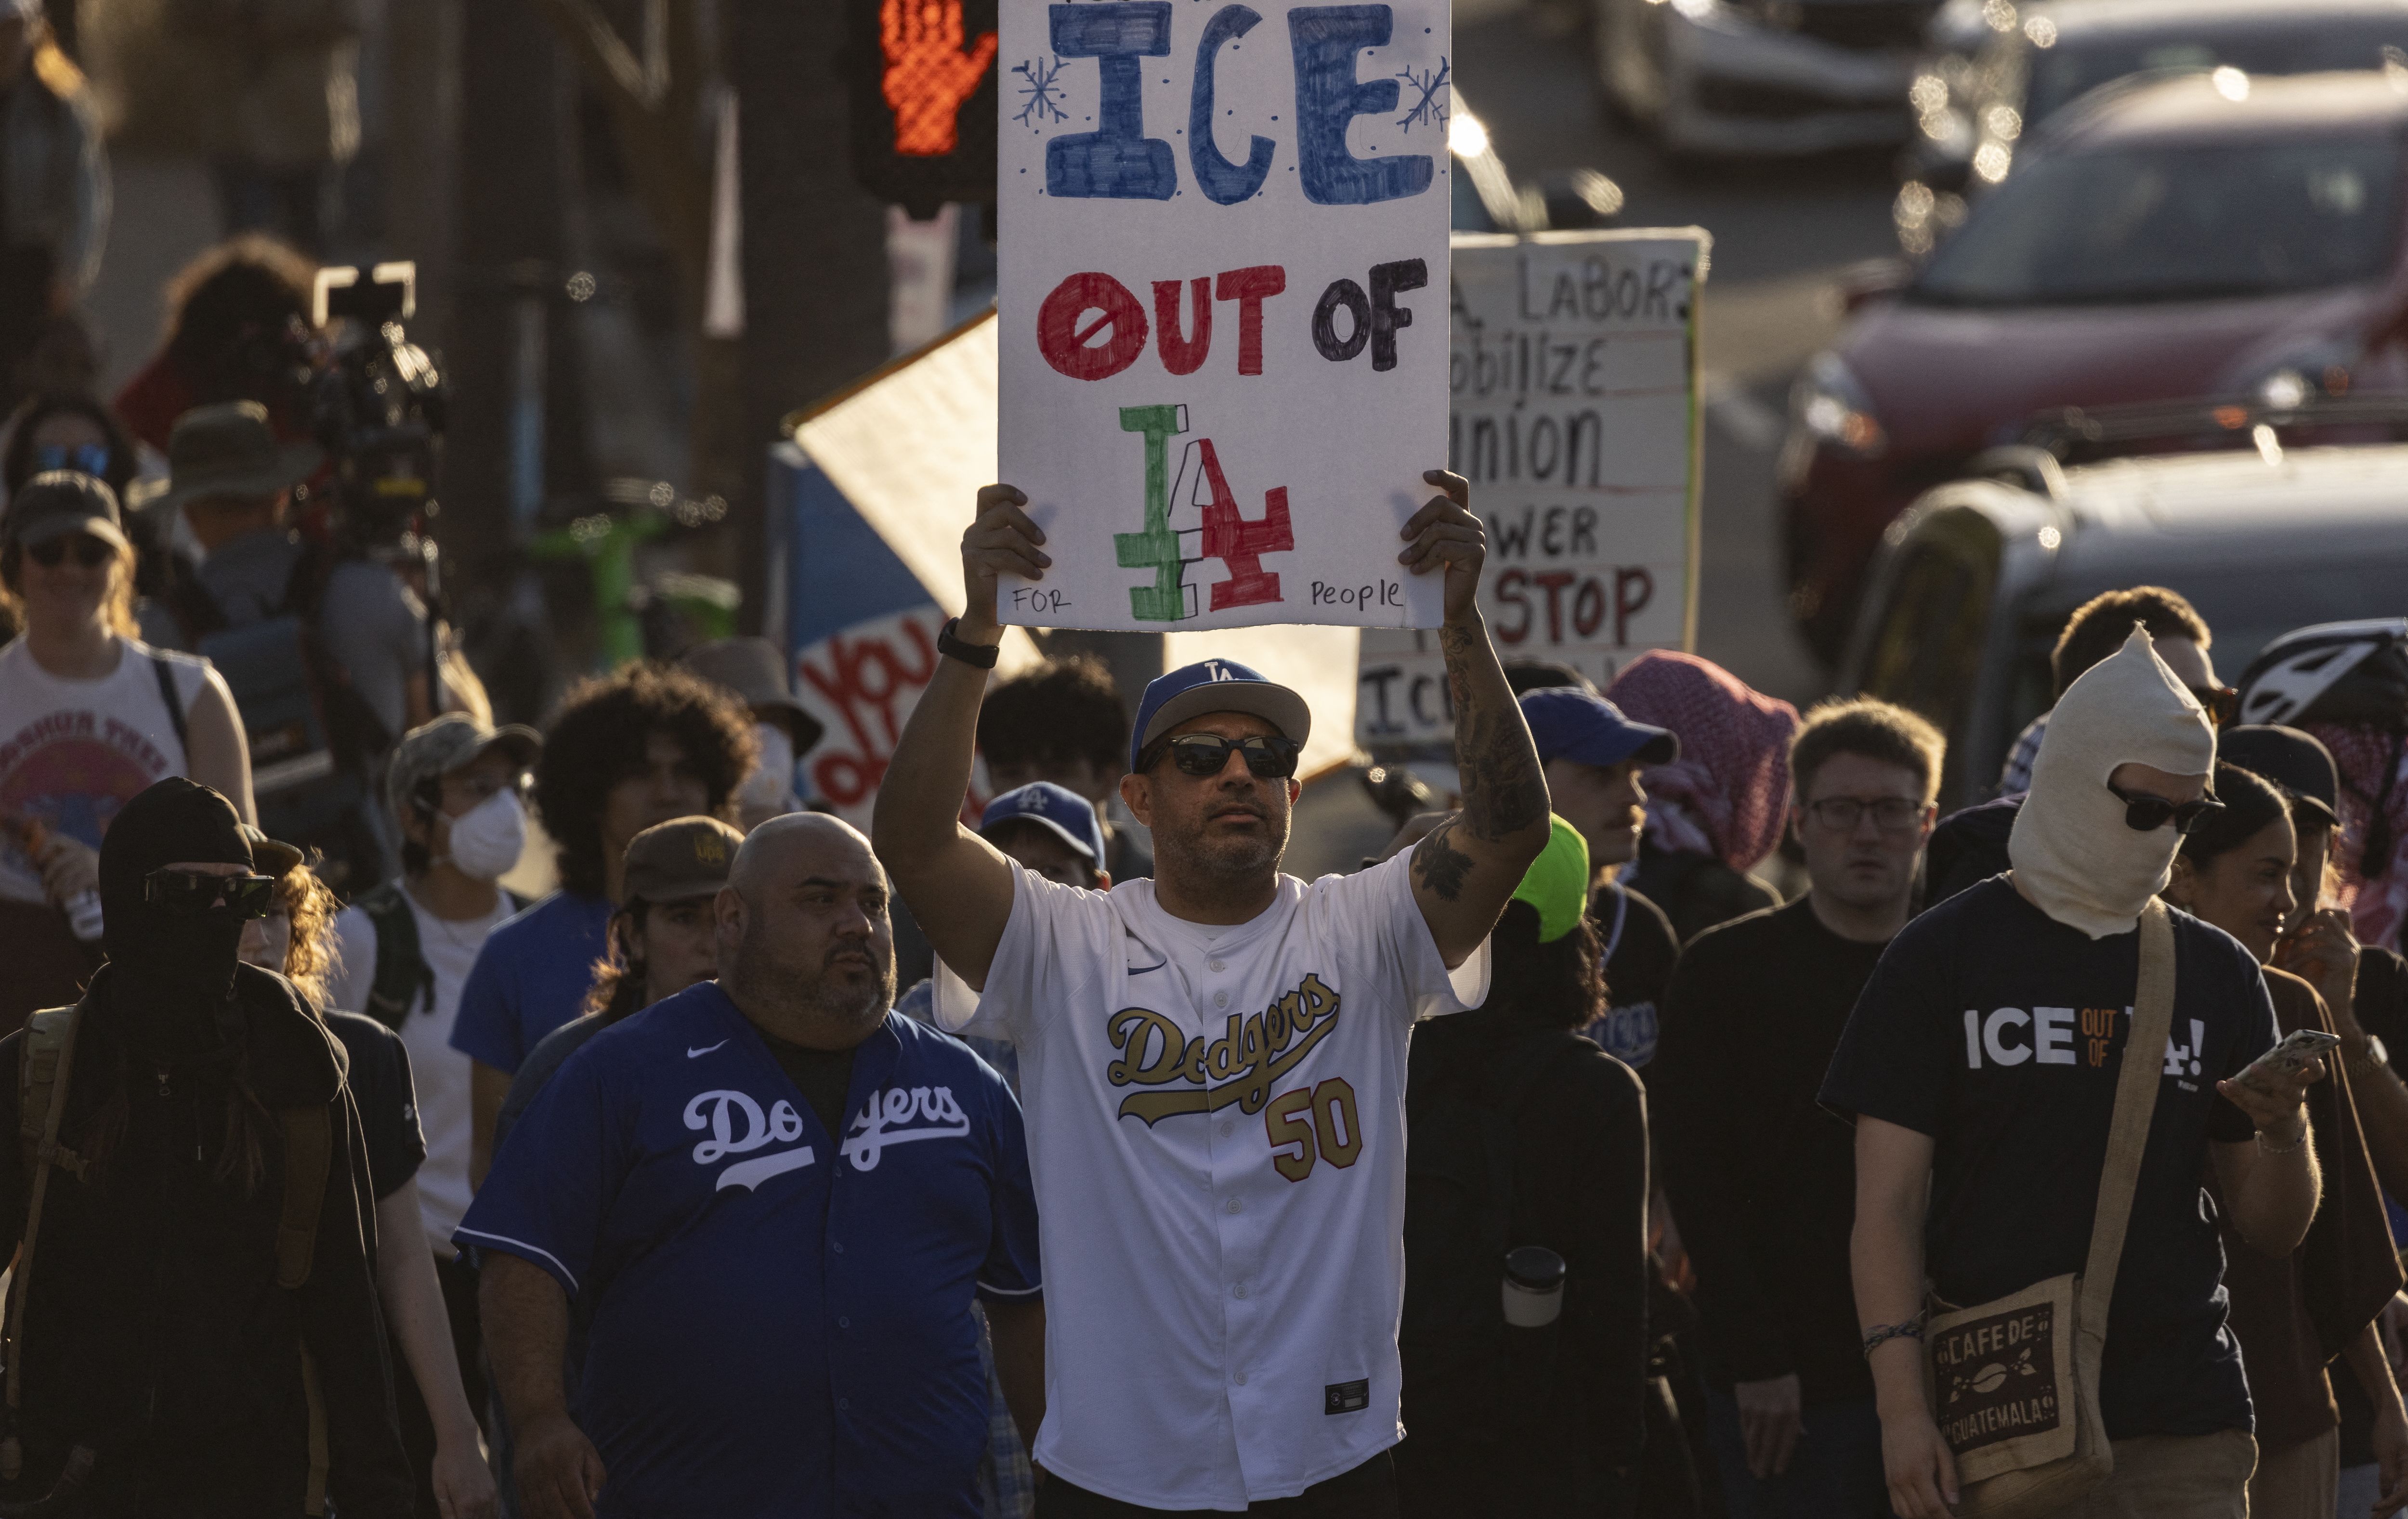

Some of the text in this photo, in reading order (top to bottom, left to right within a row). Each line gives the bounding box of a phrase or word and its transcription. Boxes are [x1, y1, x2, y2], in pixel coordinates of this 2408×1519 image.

[1046, 3, 1434, 205] ICE
[1037, 258, 1427, 381] OUT OF
[1451, 399, 1602, 487] nion
[1113, 404, 1294, 621] LA
[1488, 504, 1599, 560] WER
[1013, 580, 1404, 613] FOR People
[1493, 567, 1655, 647] STOP
[1107, 973, 1341, 1116] Dodgers
[1964, 1006, 2077, 1069] ICE
[2081, 1008, 2118, 1039] OUT
[2088, 1040, 2109, 1068] OF
[1265, 1077, 1362, 1182] 50
[1948, 1315, 2035, 1364] CAFE DE
[1951, 1399, 2043, 1444] GUATEMALA
